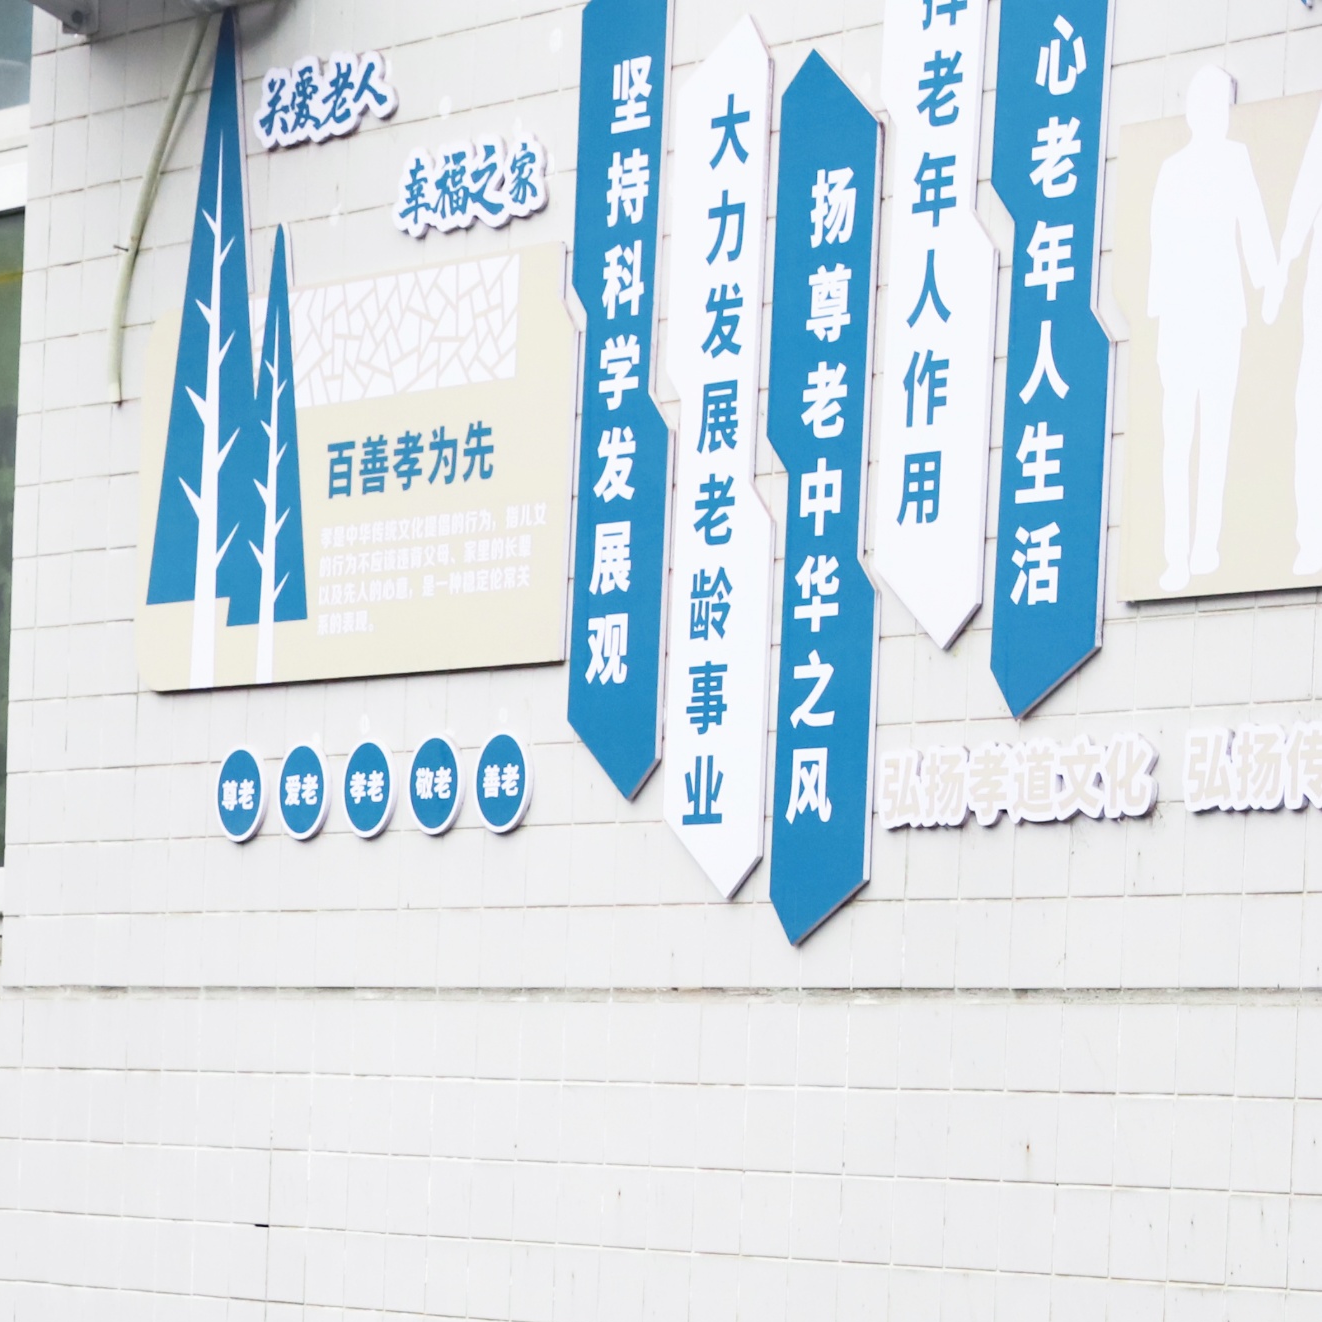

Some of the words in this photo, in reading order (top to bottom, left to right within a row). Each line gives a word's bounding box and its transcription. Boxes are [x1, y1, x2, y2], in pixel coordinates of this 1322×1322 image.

[399, 143, 539, 225] 幸福之家
[1010, 14, 1088, 606] 心老年人生活
[584, 54, 653, 687] 坚持科学发展观
[326, 420, 495, 500] 百善孝为先
[682, 93, 752, 828] 大力发展老龄事业
[785, 167, 858, 826] 扬尊老中华之风
[221, 778, 255, 812] 尊老
[284, 773, 319, 807] 爱老
[349, 769, 385, 805] 孝老
[415, 765, 453, 801] 敬老
[482, 763, 520, 799] 善老
[883, 740, 1148, 822] 弘扬孝道文化
